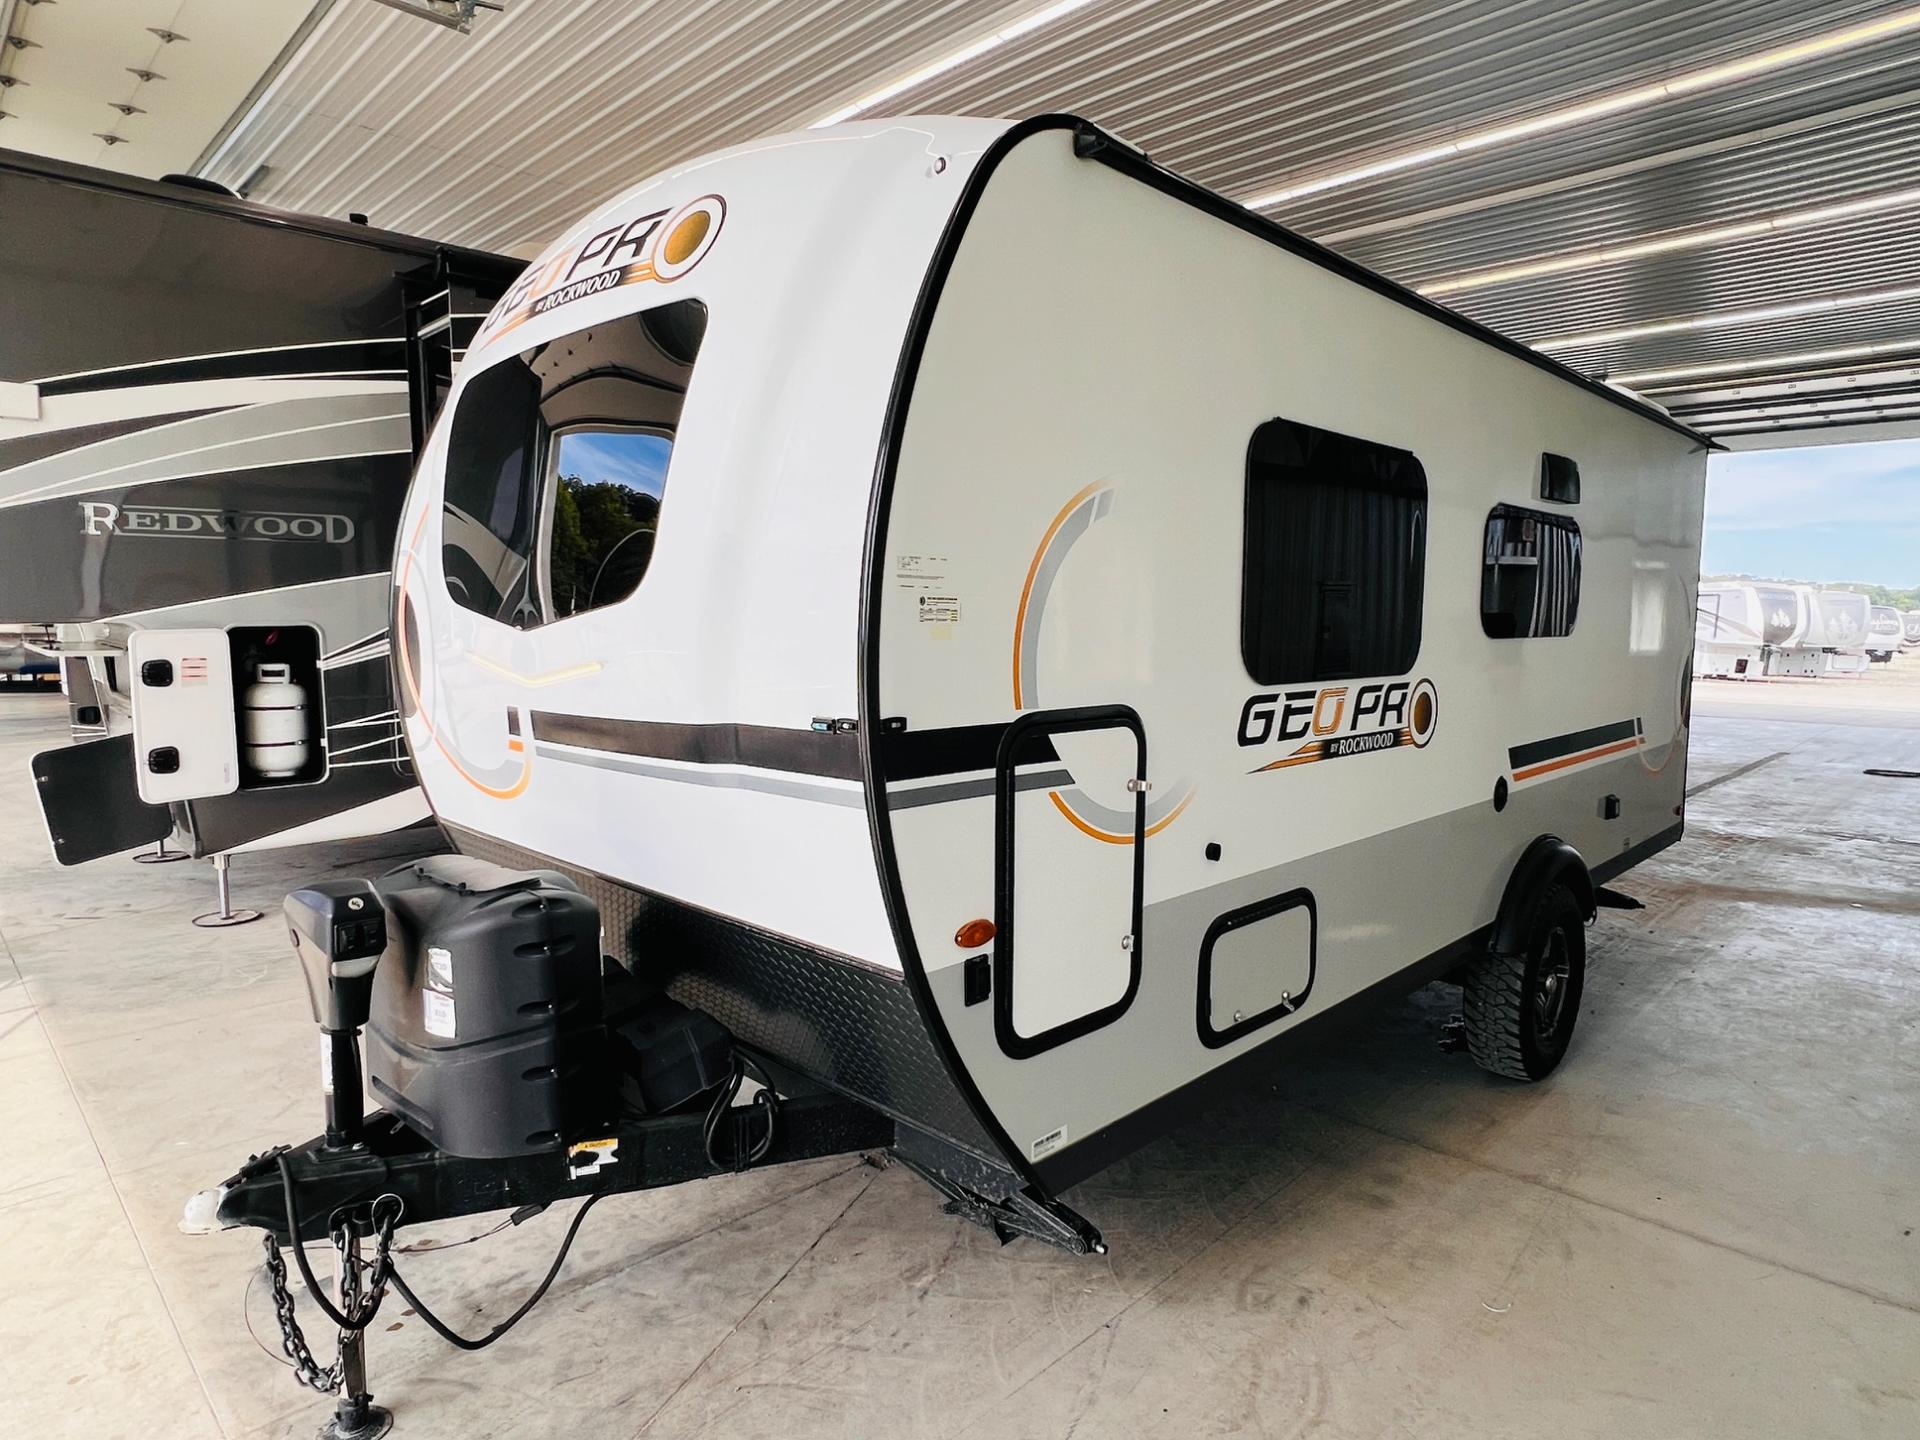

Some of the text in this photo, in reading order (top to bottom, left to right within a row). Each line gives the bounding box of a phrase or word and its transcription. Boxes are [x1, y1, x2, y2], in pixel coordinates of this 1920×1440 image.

[563, 194, 728, 283] PRO
[543, 270, 621, 311] ROCKWOOD
[78, 501, 355, 543] REDWOOD
[1237, 678, 1438, 749] GEO PRO
[1338, 732, 1394, 755] ROCKWOOD
